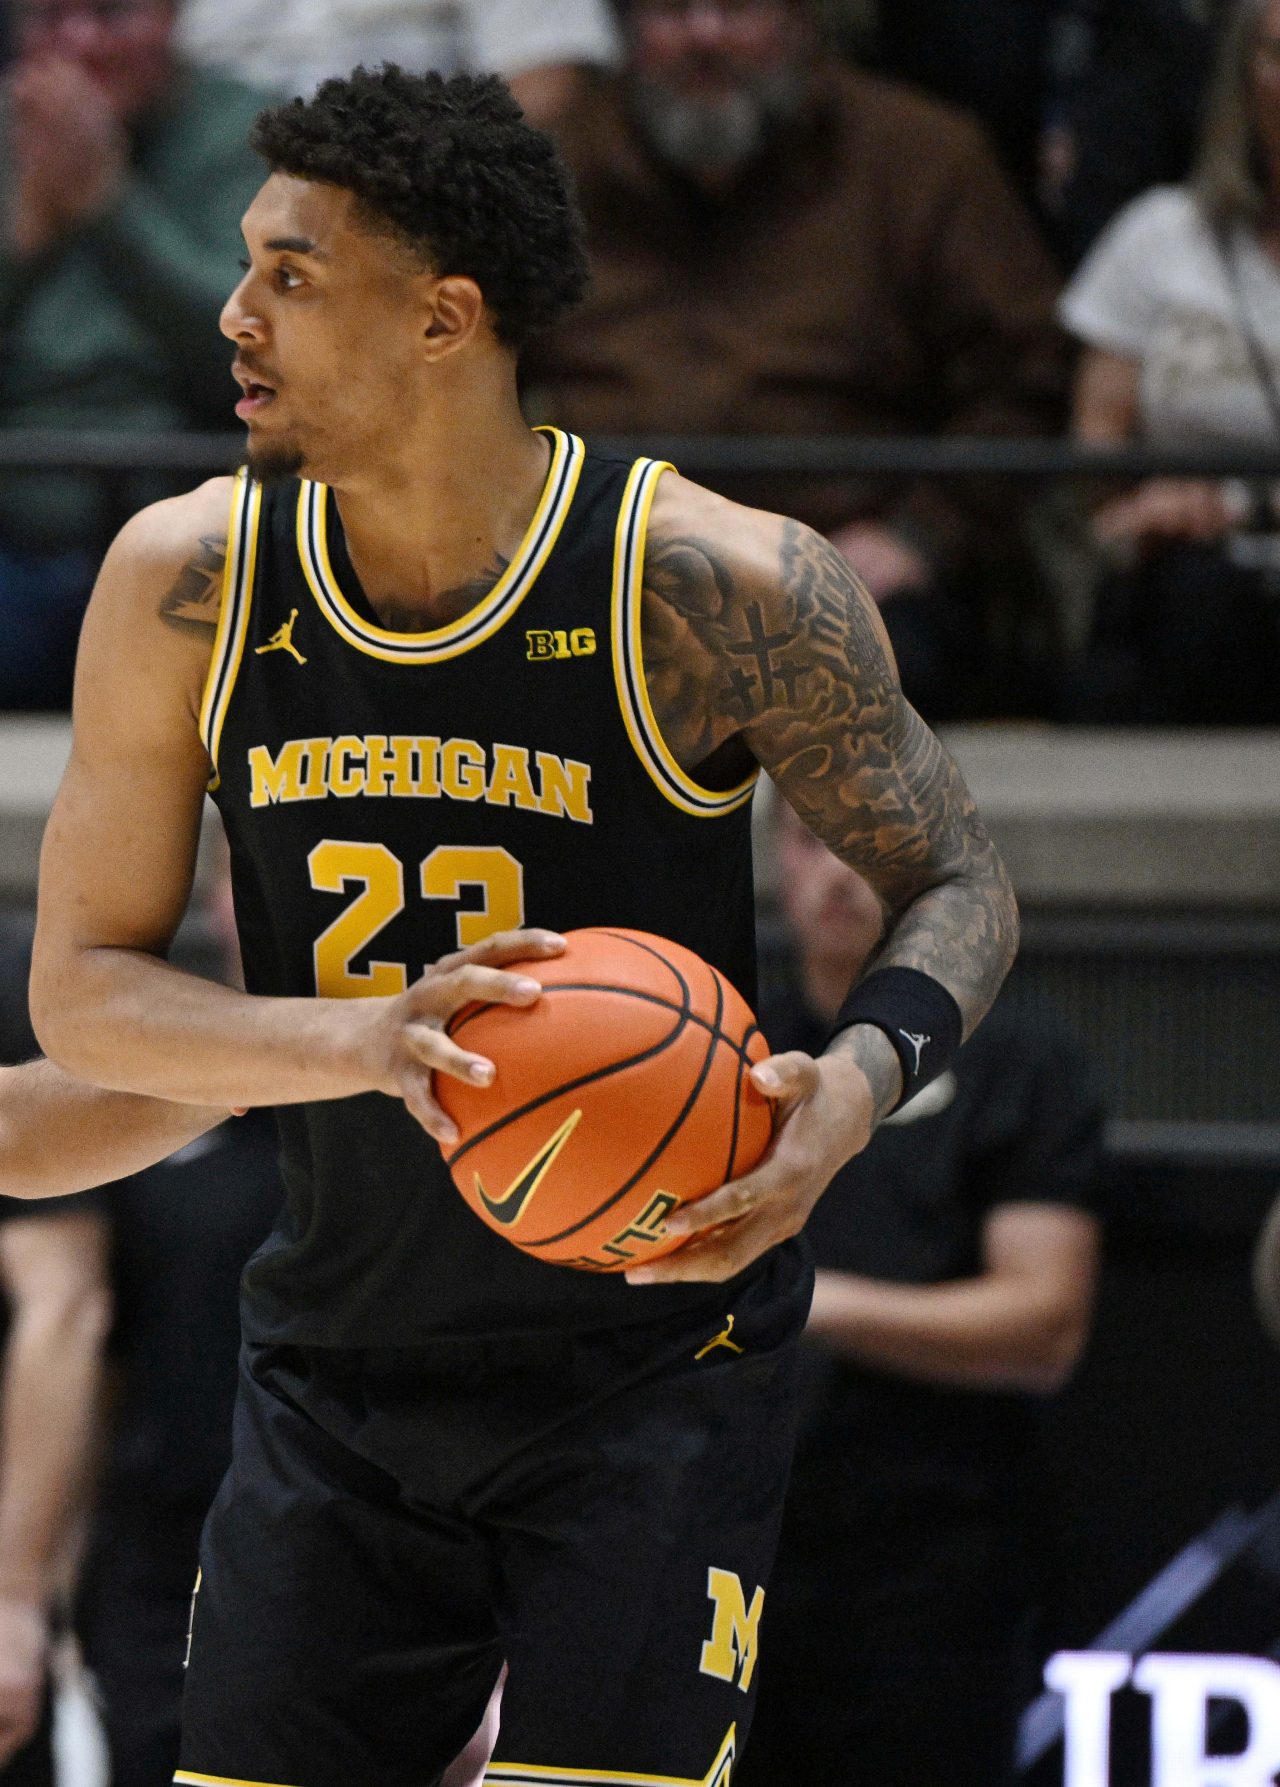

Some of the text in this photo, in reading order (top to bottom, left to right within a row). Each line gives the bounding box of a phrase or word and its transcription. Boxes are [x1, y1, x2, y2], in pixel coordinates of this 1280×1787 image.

[248, 734, 594, 825] MICHIGAN
[306, 838, 525, 998] 23
[699, 1565, 765, 1694] M
